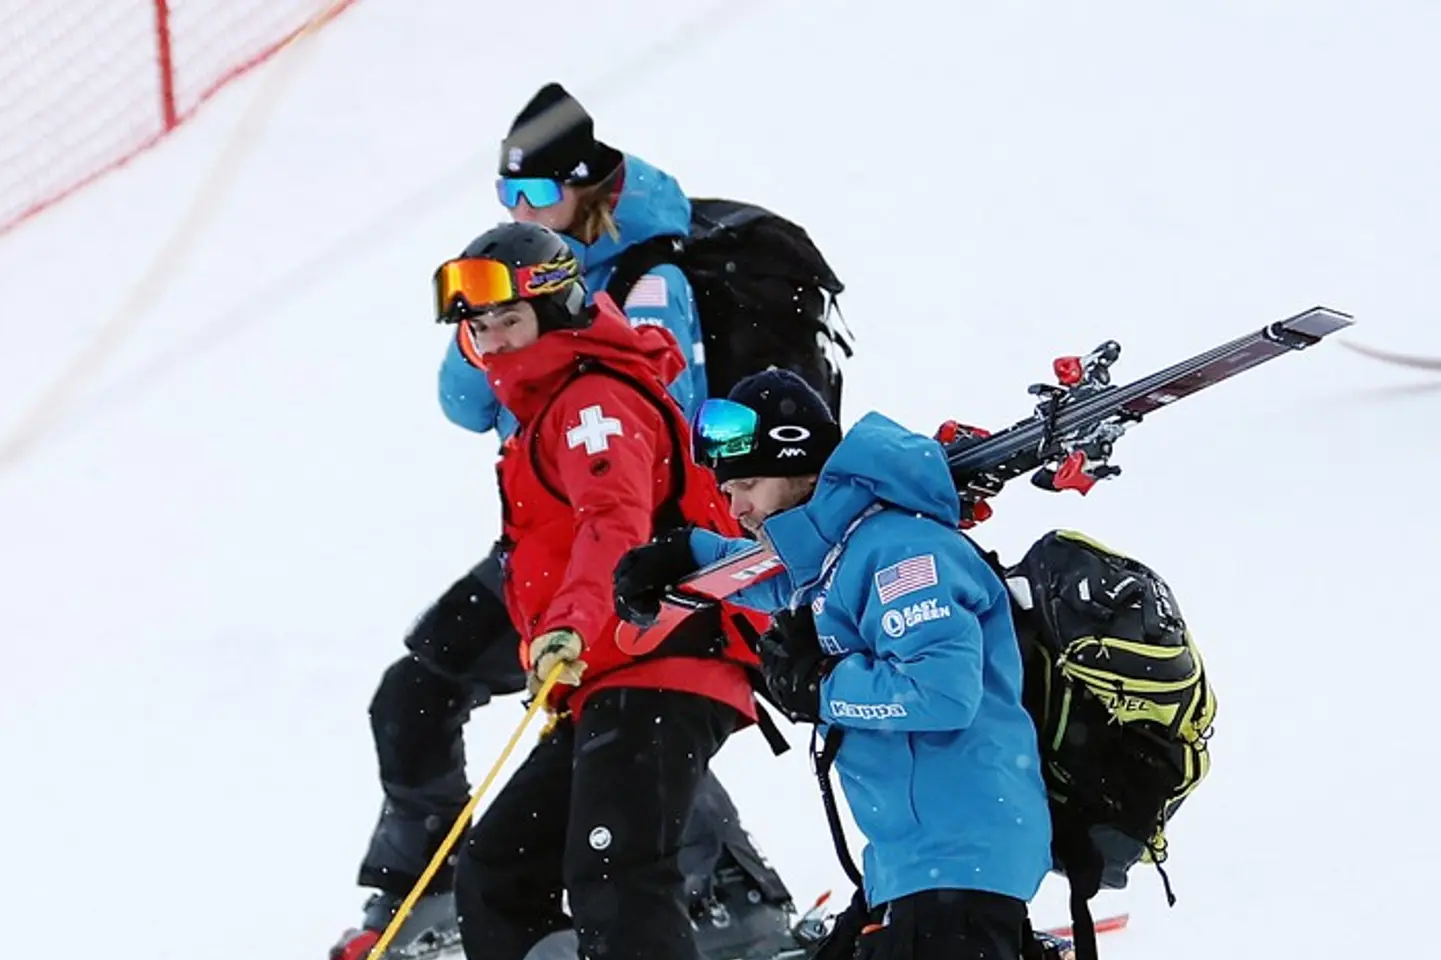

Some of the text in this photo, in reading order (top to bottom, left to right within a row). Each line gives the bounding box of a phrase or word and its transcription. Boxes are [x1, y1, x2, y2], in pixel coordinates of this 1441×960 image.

[903, 598, 938, 618] EASY
[906, 605, 951, 627] GREEN
[830, 700, 907, 719] Kappa
